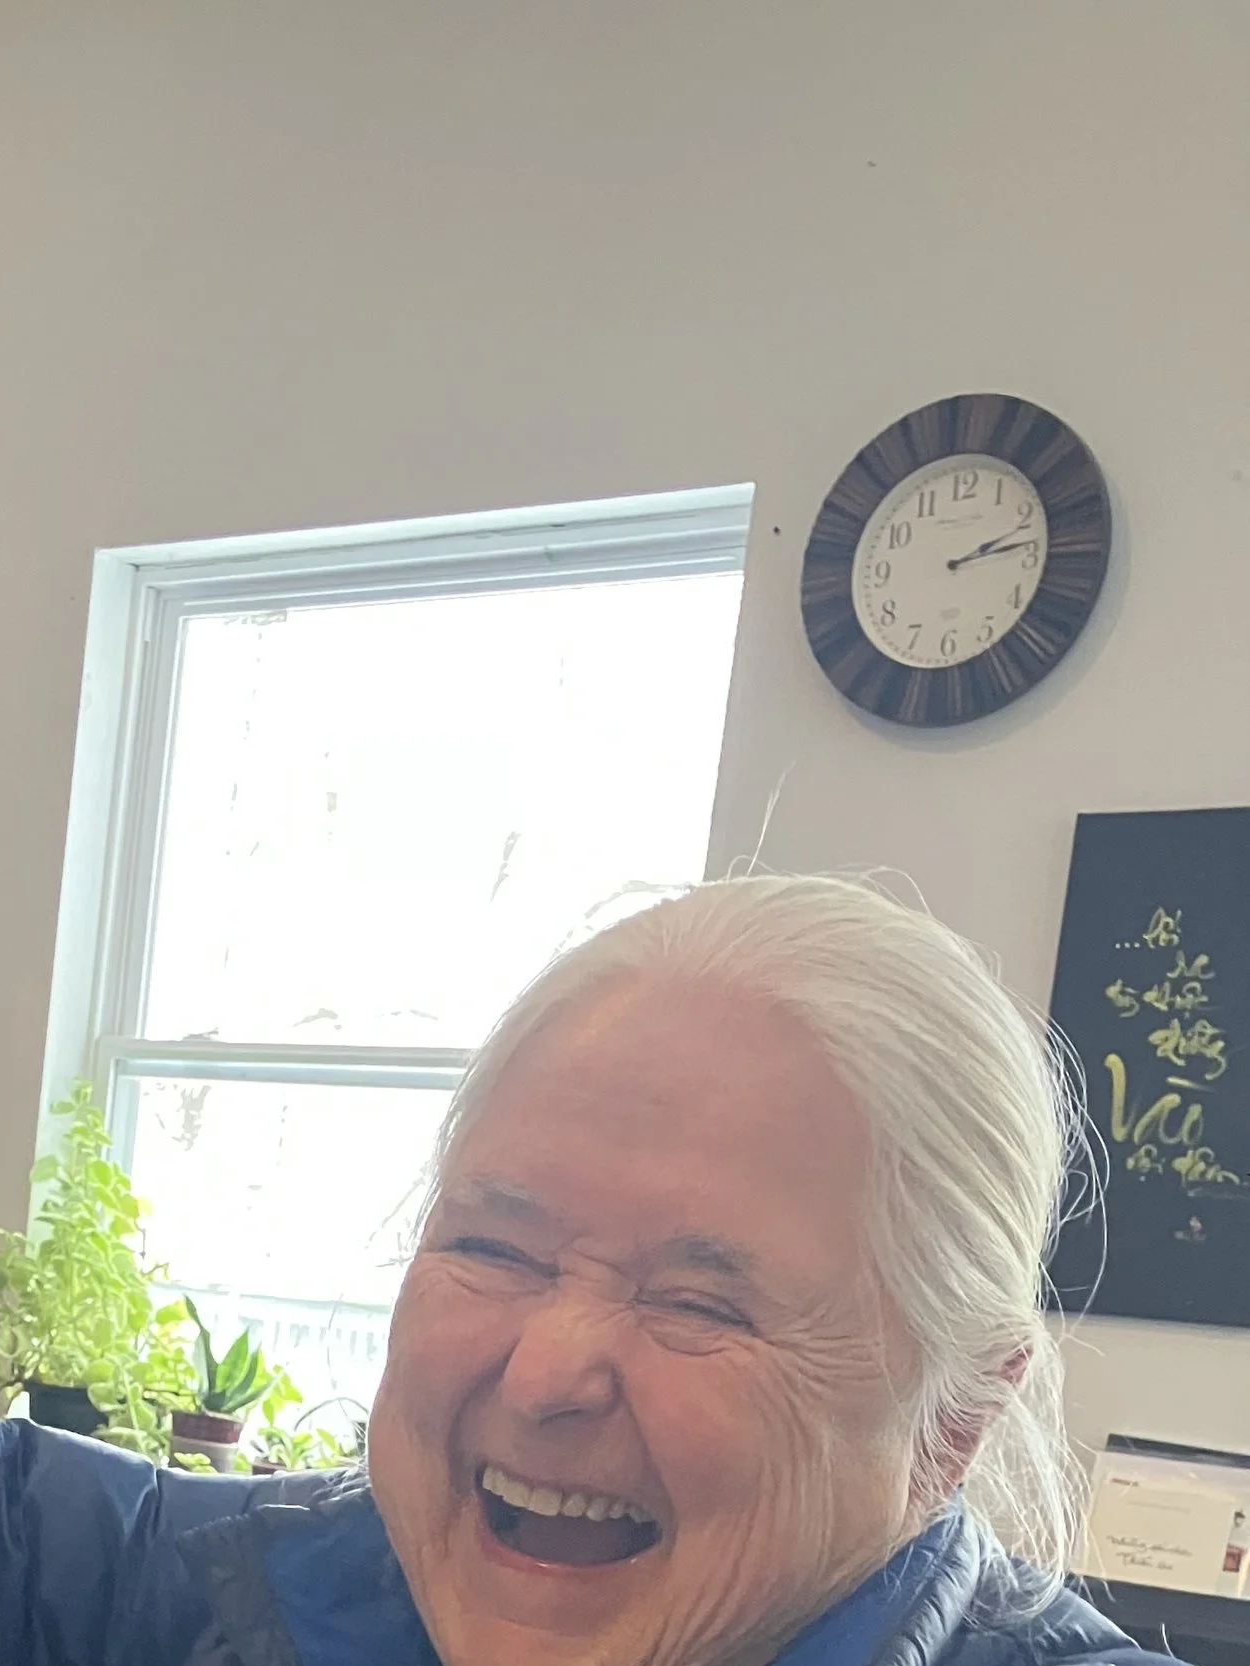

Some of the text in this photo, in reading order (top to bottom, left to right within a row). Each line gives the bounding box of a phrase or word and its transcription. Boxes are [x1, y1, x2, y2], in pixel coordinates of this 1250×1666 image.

[950, 471, 980, 502] 12
[993, 477, 1004, 507] 1
[916, 490, 937, 519] 11
[1017, 501, 1035, 530] 2
[888, 521, 913, 550] 10
[1020, 540, 1040, 570] 3
[874, 560, 892, 588] 9
[1005, 583, 1023, 610] 4
[880, 599, 897, 627] 8
[906, 623, 923, 651] 7
[940, 629, 957, 657] 6
[976, 616, 995, 644] 5
